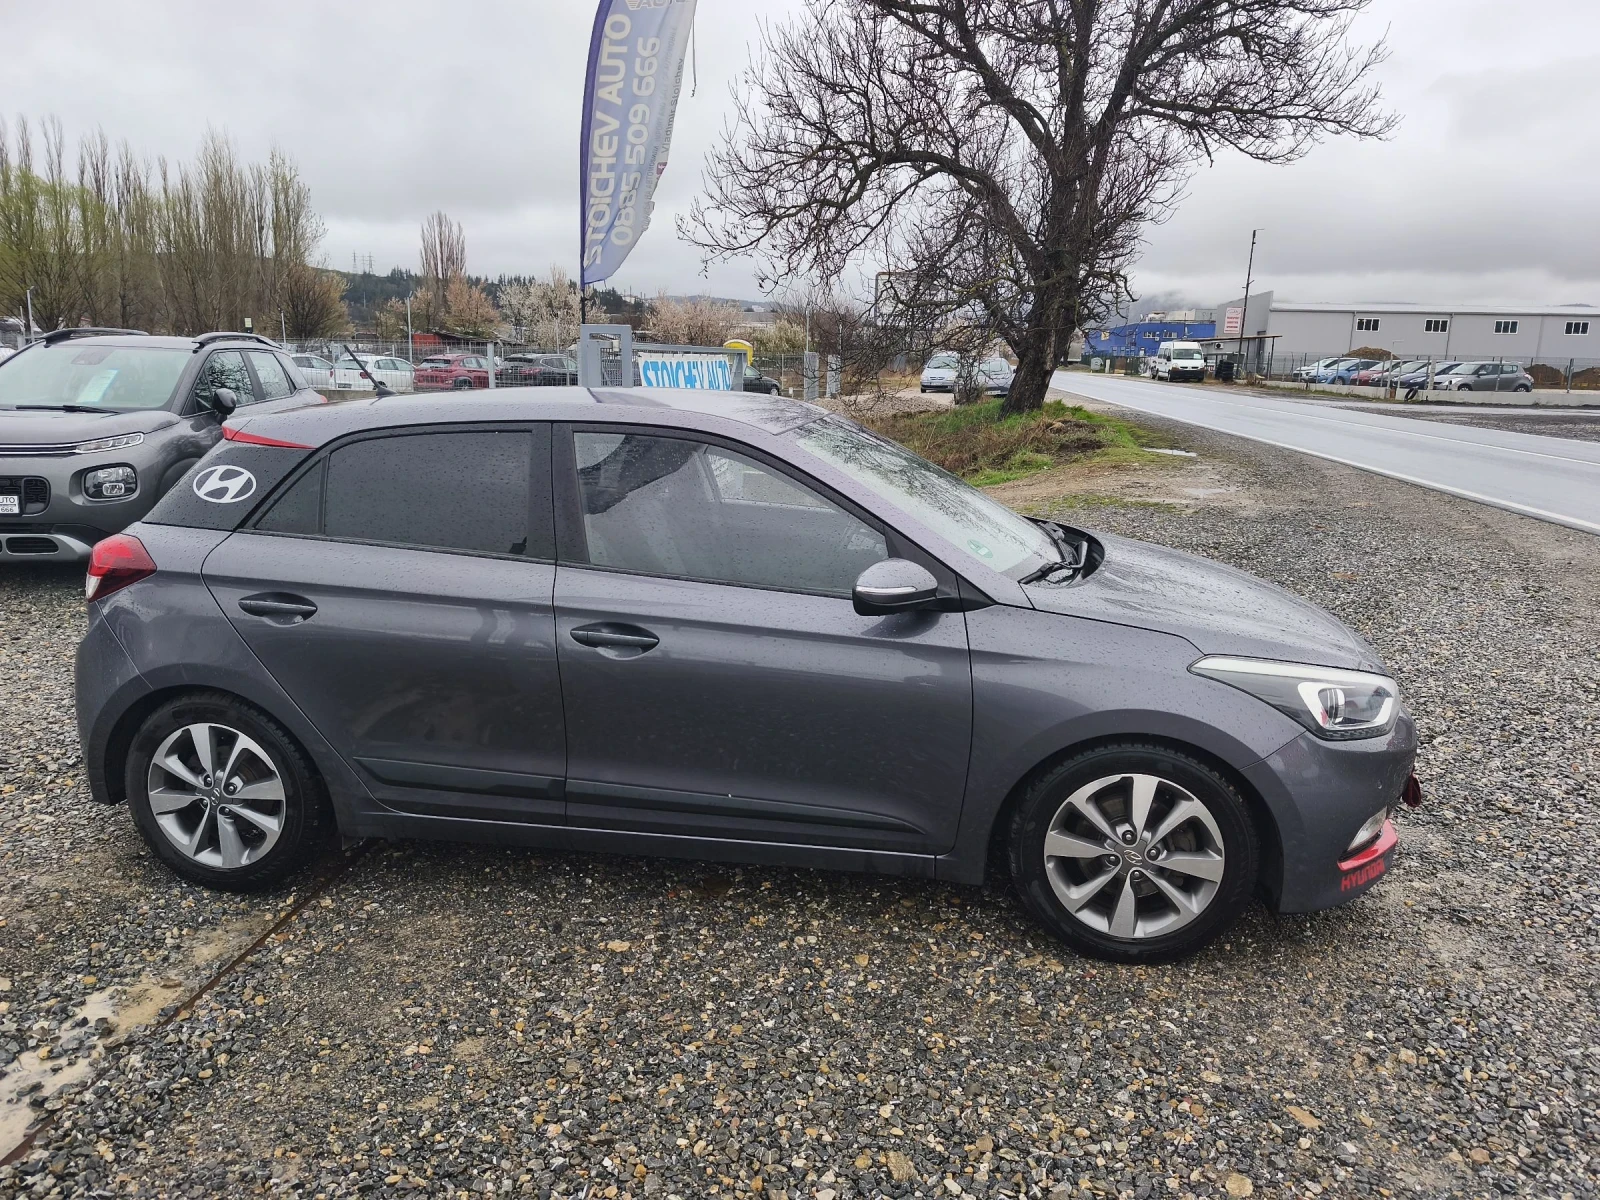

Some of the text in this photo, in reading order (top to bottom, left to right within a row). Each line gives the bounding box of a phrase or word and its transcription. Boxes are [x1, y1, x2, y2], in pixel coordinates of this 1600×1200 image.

[632, 37, 660, 96] 666
[583, 13, 631, 270] STOICHEV AUTO
[624, 103, 650, 165] 509
[661, 110, 675, 154] Vladimir
[610, 171, 642, 246] 0885
[642, 360, 731, 391] STOICHEV AUTO
